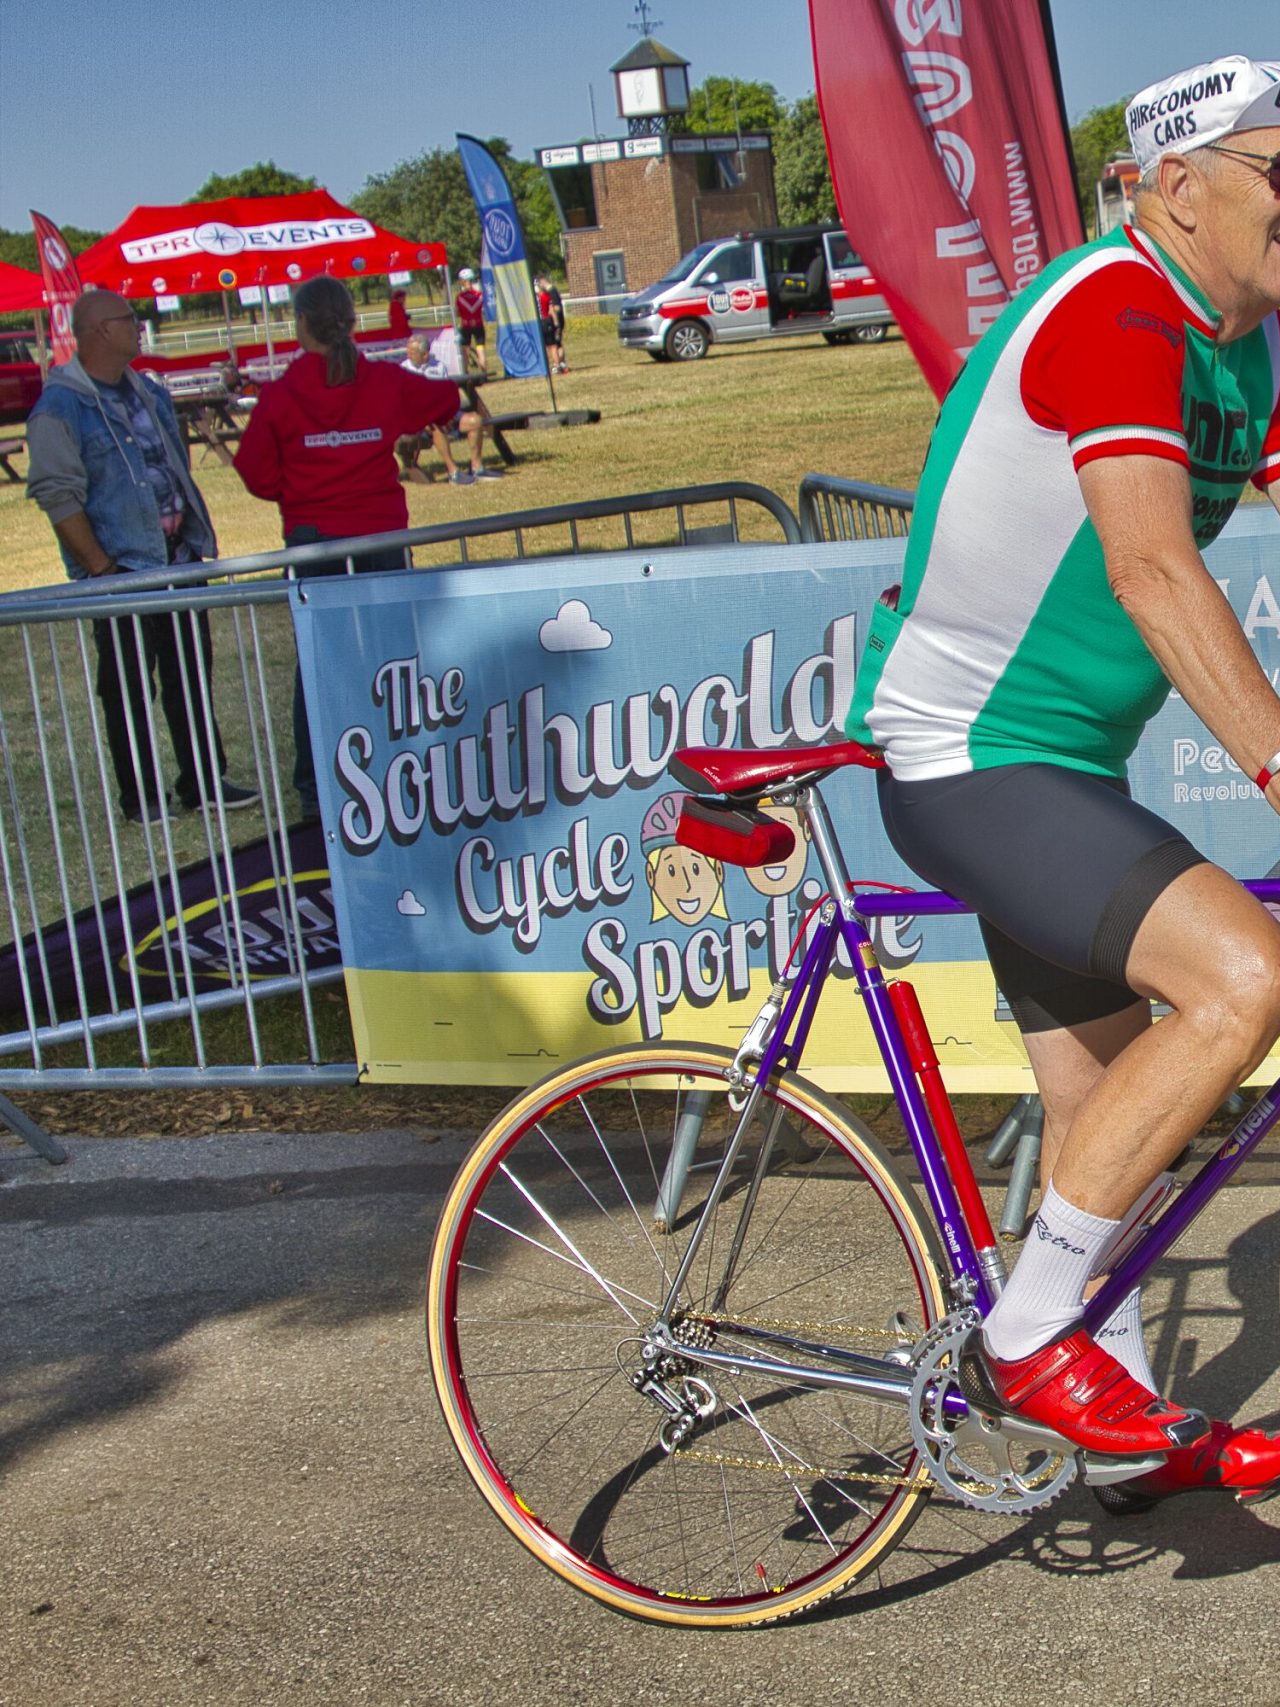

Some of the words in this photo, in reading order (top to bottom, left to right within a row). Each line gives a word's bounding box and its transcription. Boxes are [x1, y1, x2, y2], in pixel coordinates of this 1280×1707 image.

[1130, 72, 1236, 133] HIRECONOMY
[1154, 111, 1196, 146] CARS
[129, 236, 190, 258] TPR
[248, 221, 367, 247] EVENTS
[374, 652, 467, 738] The
[336, 612, 860, 848] Southwold
[455, 817, 634, 951] Cycle
[1035, 1214, 1086, 1255] Retro
